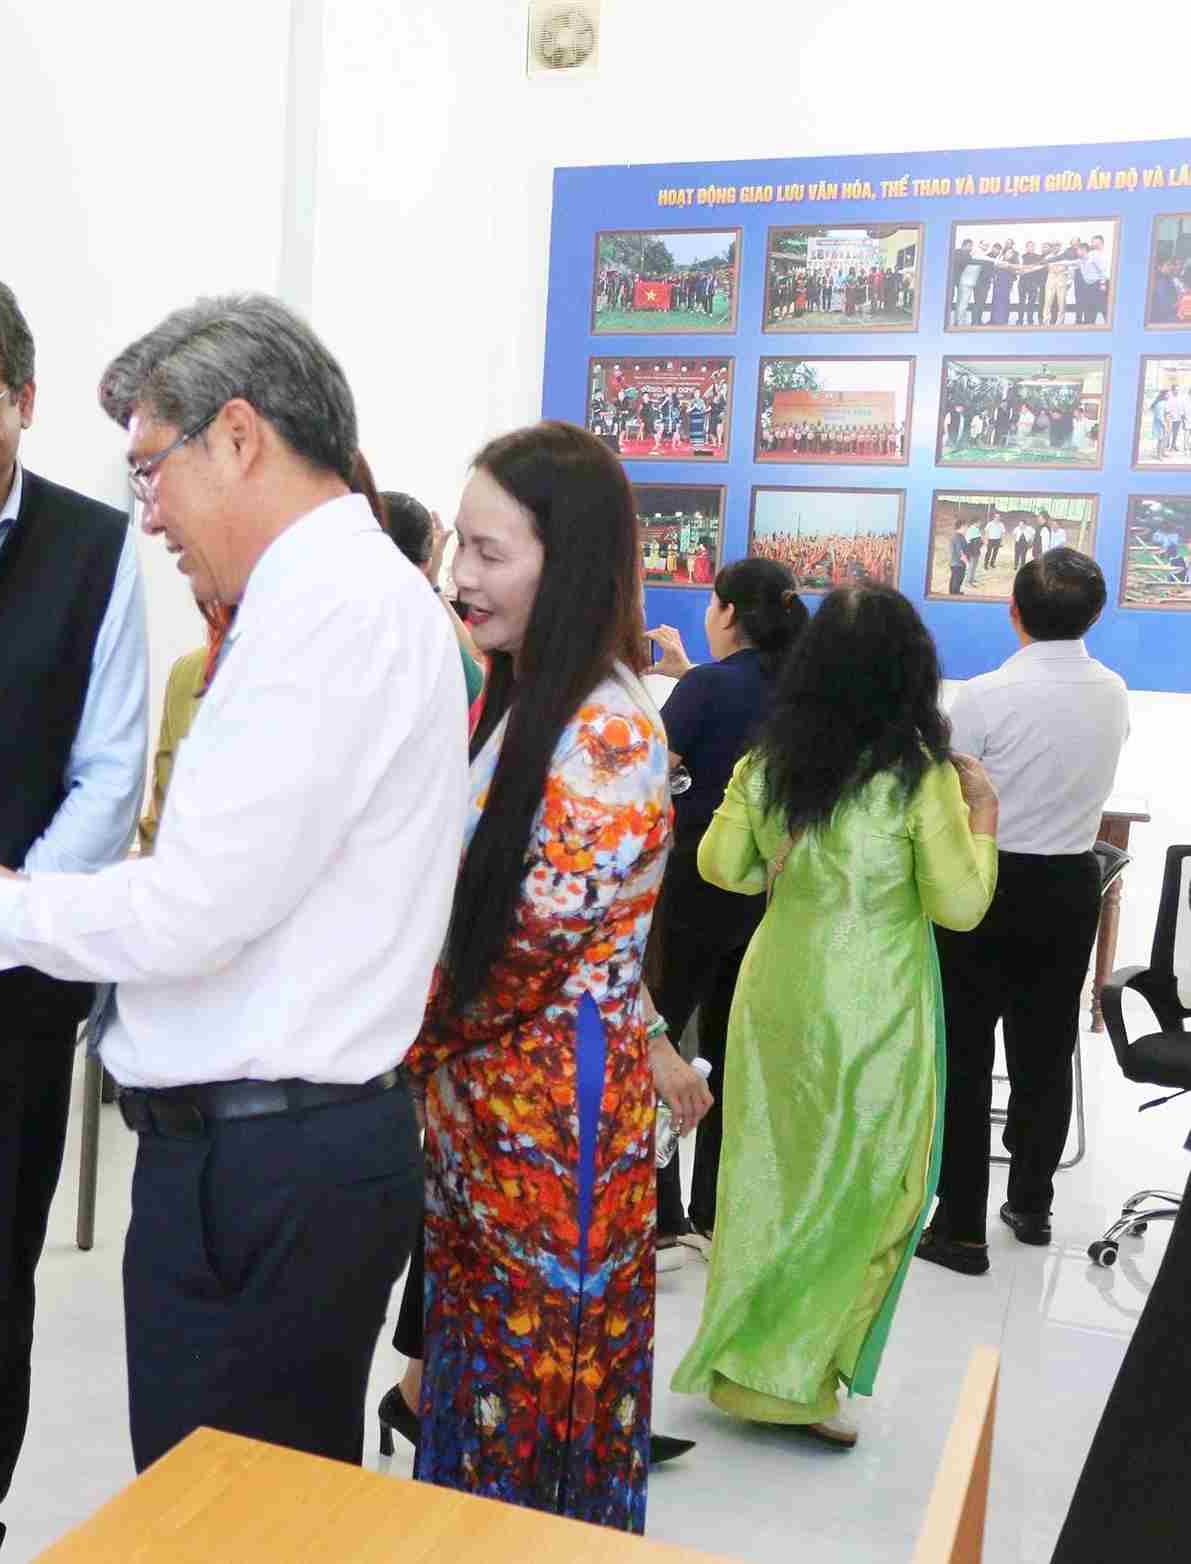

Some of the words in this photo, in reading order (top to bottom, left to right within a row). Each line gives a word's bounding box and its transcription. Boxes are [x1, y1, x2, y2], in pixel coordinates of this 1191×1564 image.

[658, 187, 694, 208] HOẠT
[697, 184, 736, 208] ĐỘNG
[740, 184, 773, 204] GIAO
[776, 182, 805, 203] LƯU
[808, 180, 839, 202] VĂN
[880, 174, 910, 199] THỂ
[913, 178, 950, 198] THAO
[955, 174, 975, 196] VÀ
[979, 177, 1000, 195] DU
[1004, 175, 1041, 199] LỊCH
[1045, 171, 1083, 193] GIỮA
[1087, 166, 1113, 191] ẤN
[1116, 167, 1137, 192] ĐỘ
[1142, 165, 1165, 189] VÀ
